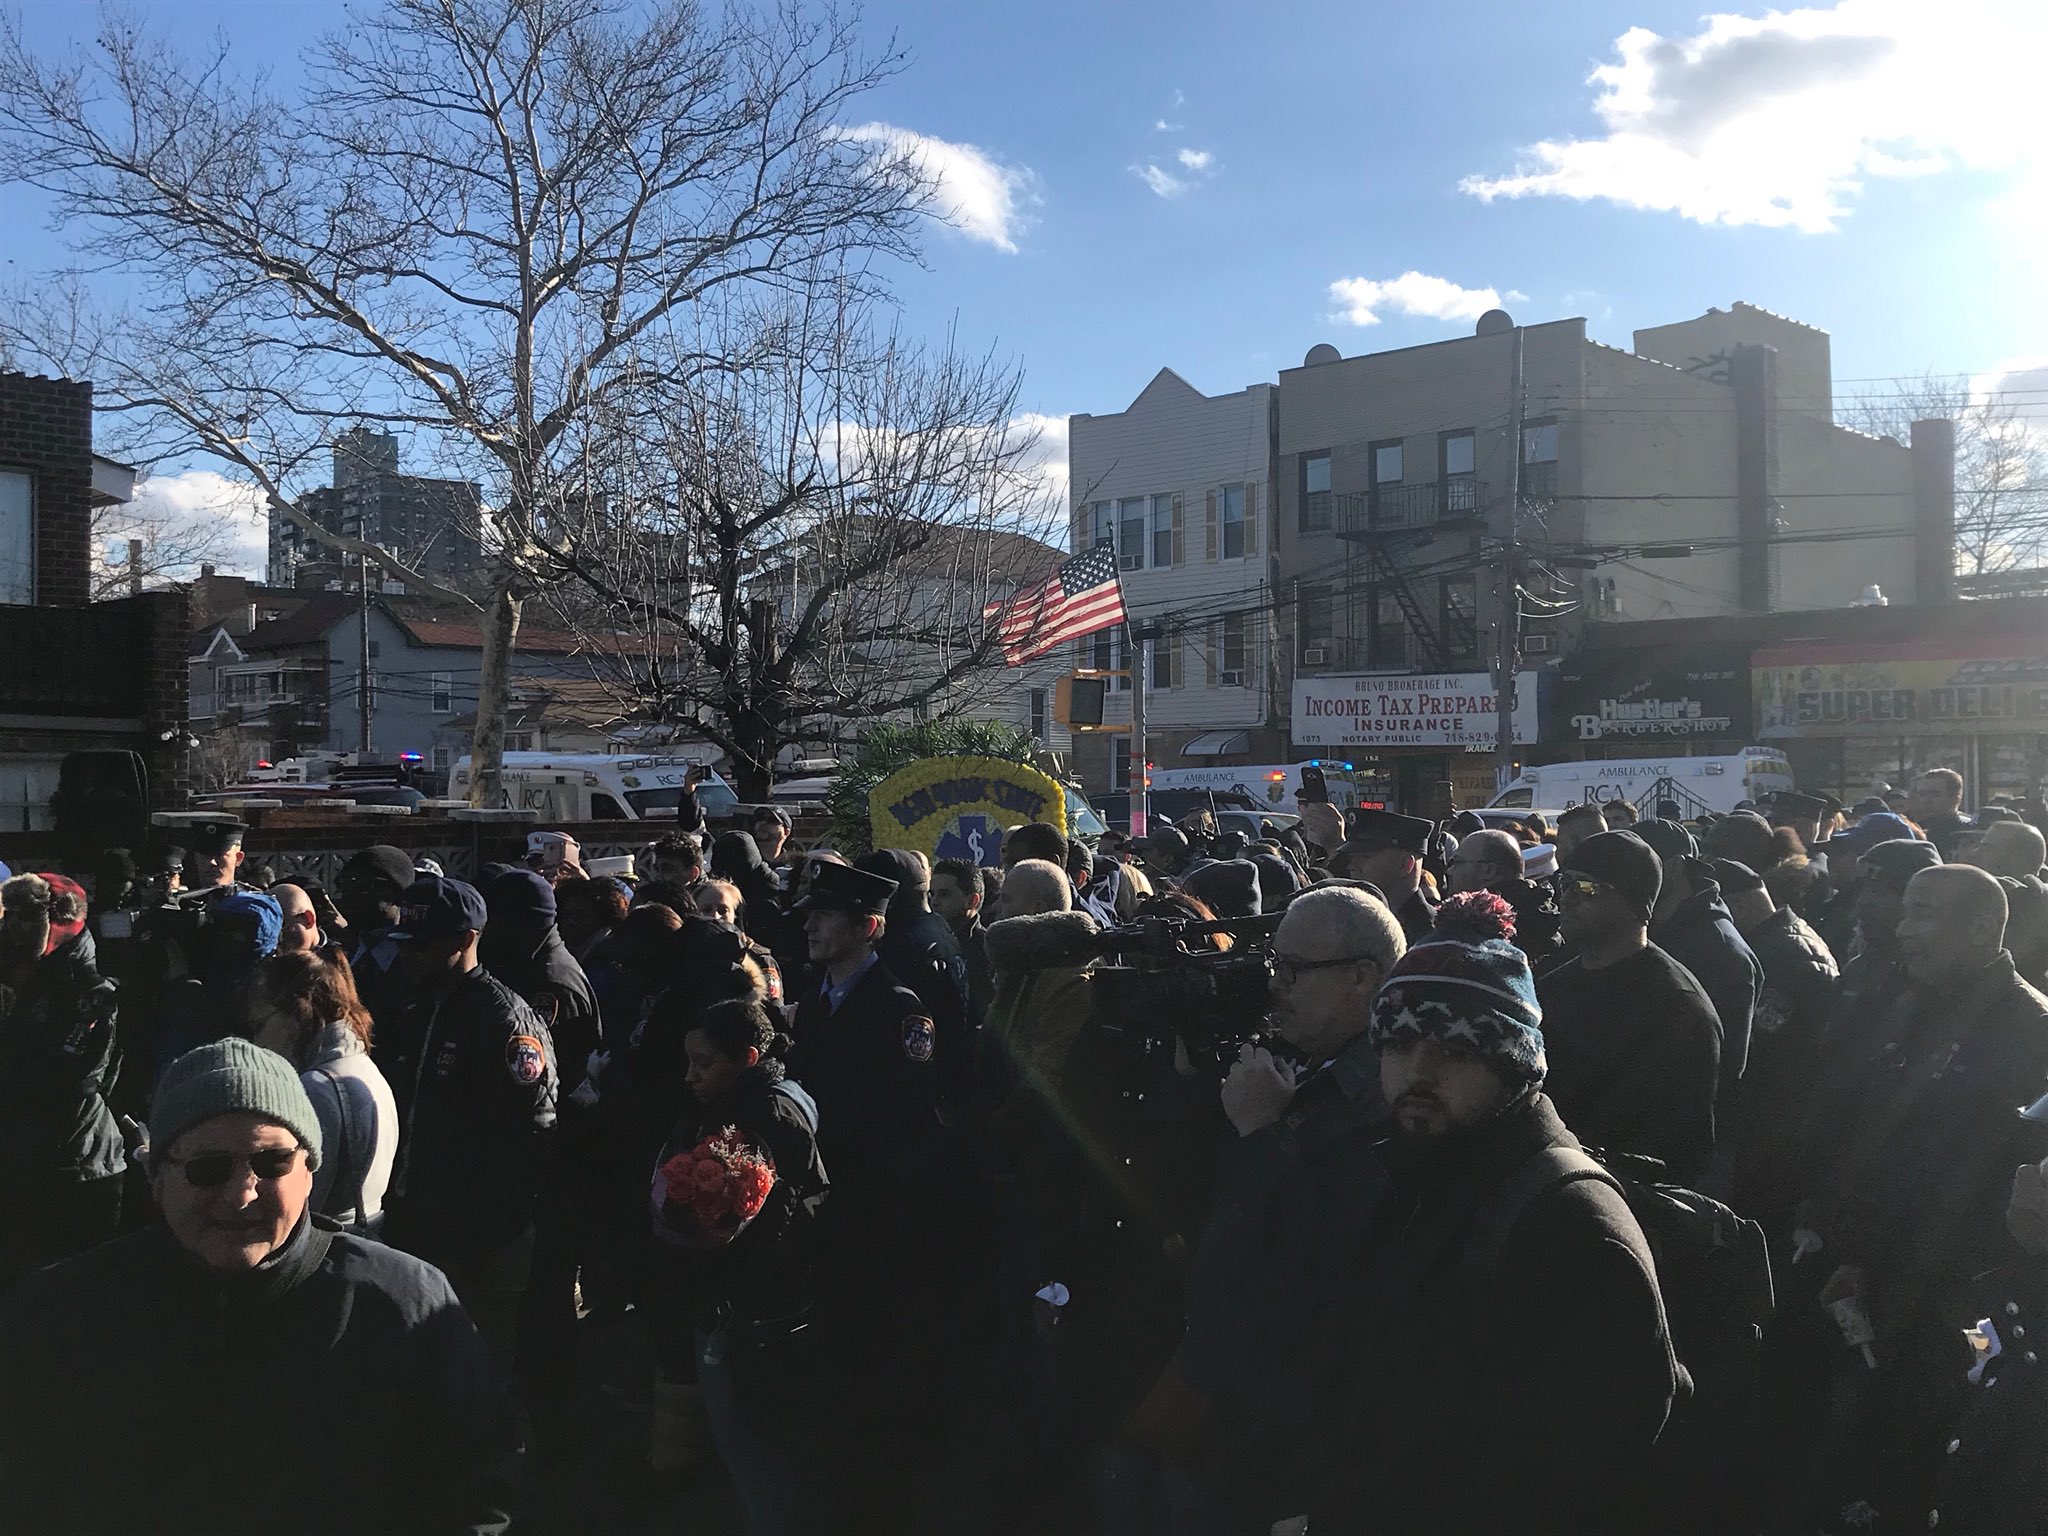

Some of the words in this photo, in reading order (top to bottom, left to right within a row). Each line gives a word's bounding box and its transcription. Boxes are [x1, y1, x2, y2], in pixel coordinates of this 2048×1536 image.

[1387, 679, 1441, 691] BROKERAGE
[1444, 678, 1463, 690] INC.
[1304, 696, 1372, 717] INCOME
[1377, 695, 1414, 715] TAX
[1599, 696, 1703, 721] Hustler's
[1797, 688, 1917, 722] SUPER
[1929, 686, 2016, 720] DELI
[1353, 718, 1464, 731] INSURANCE
[1571, 713, 1679, 740] BARBER
[1679, 717, 1732, 735] SHOP
[1301, 734, 1321, 743] 1073
[1342, 735, 1382, 743] NOTARY
[1384, 734, 1422, 743] PUBLIC
[501, 771, 531, 783] ULANCE
[1183, 773, 1236, 783] AMBULANCE
[1598, 765, 1670, 778] AMBULANCE
[523, 788, 553, 810] RCA
[1584, 784, 1625, 804] RCA
